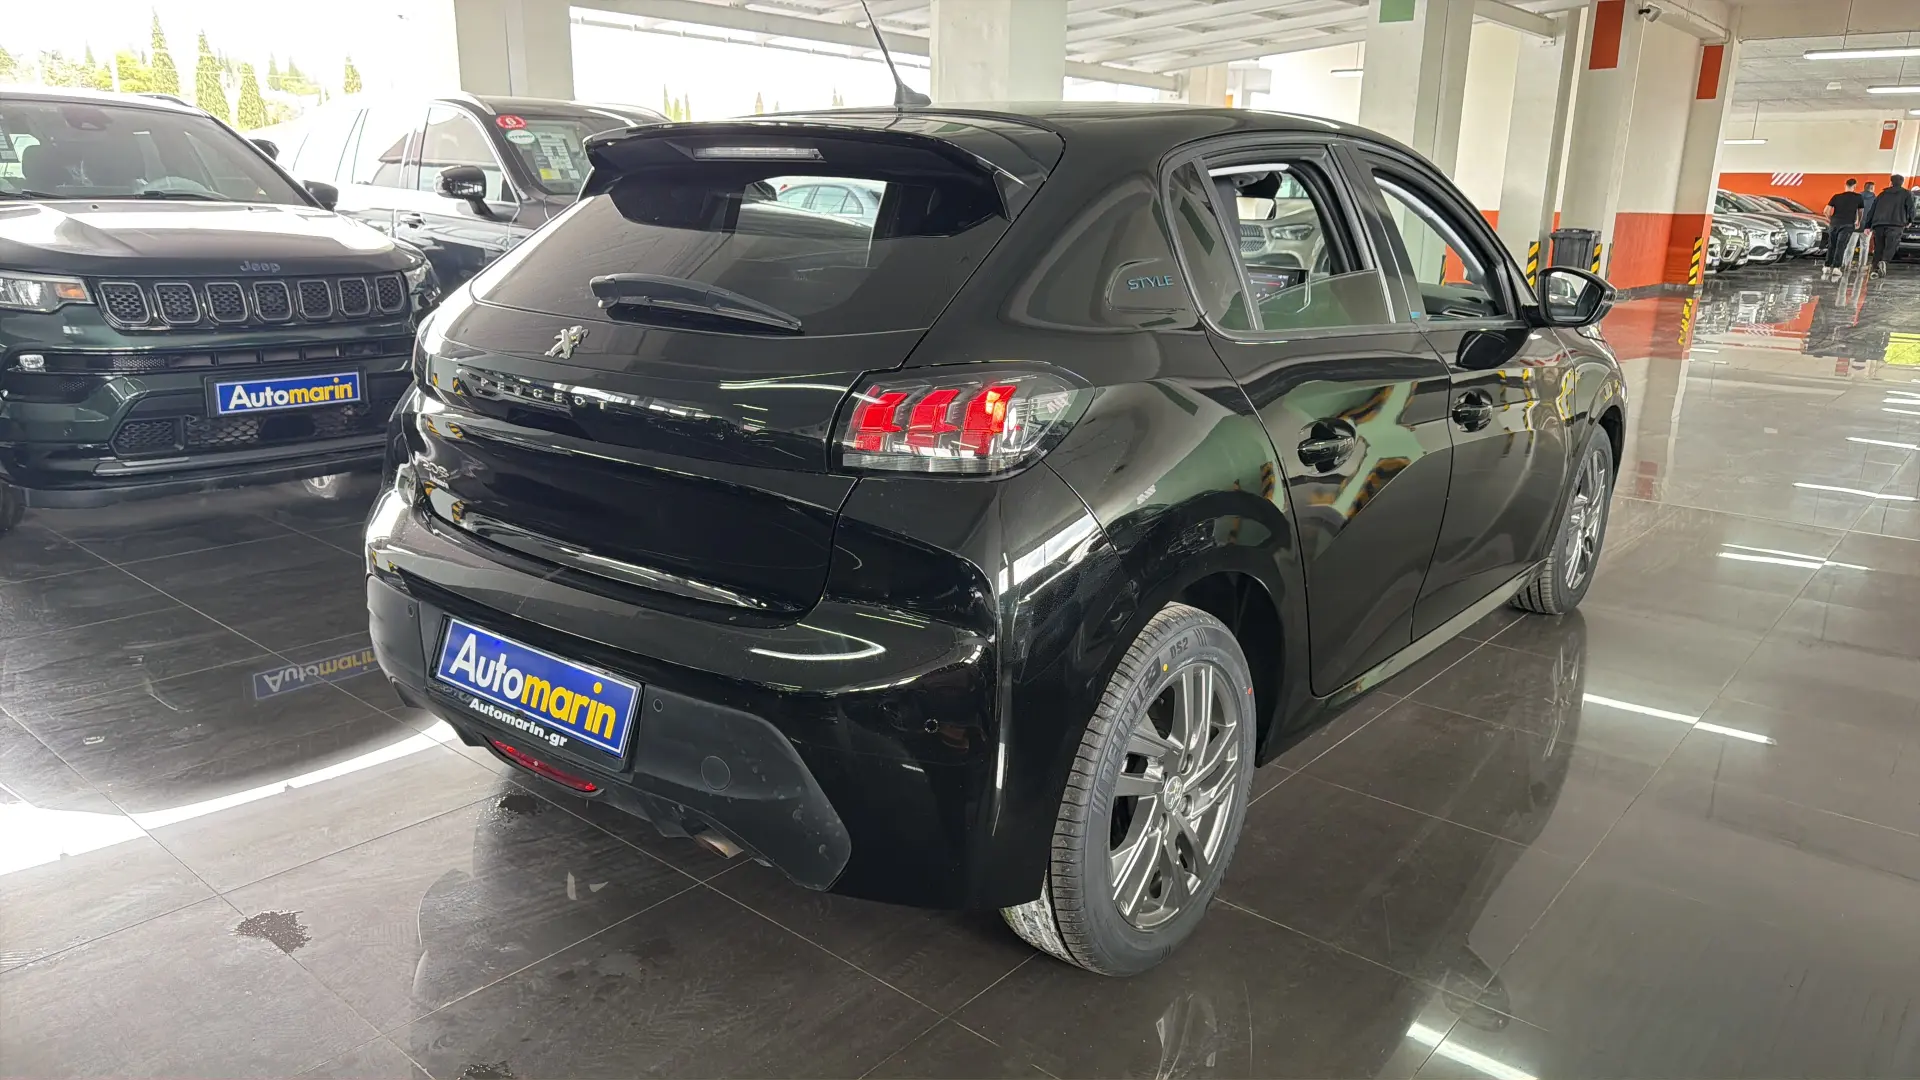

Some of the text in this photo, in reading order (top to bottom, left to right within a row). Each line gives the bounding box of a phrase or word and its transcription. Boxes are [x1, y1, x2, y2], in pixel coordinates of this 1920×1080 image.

[240, 260, 281, 273] Jeep
[1127, 275, 1175, 290] STYLE
[229, 377, 353, 409] Automarin
[480, 376, 608, 410] PEUGEOT
[1169, 636, 1190, 659] DS2
[449, 632, 617, 740] Automarin
[469, 698, 568, 747] Automarin.gr
